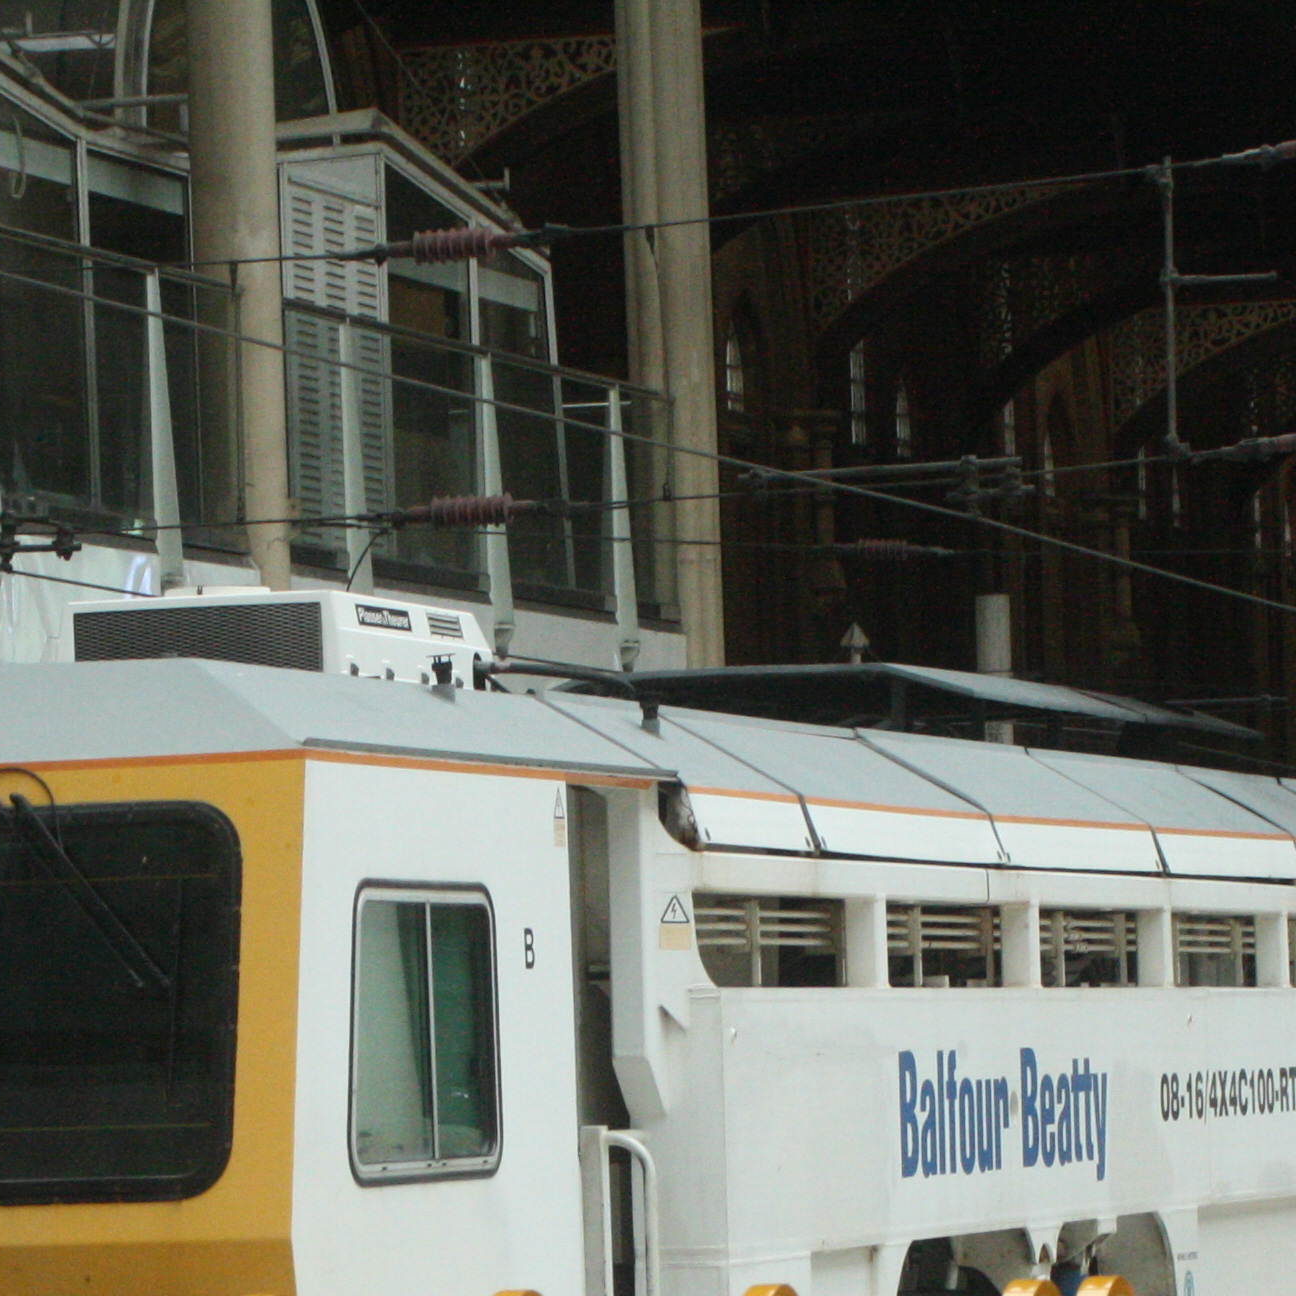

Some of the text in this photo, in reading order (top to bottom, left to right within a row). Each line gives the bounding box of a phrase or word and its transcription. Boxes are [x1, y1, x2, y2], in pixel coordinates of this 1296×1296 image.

[524, 927, 535, 969] B
[898, 1047, 1108, 1182] Balfour Beatty
